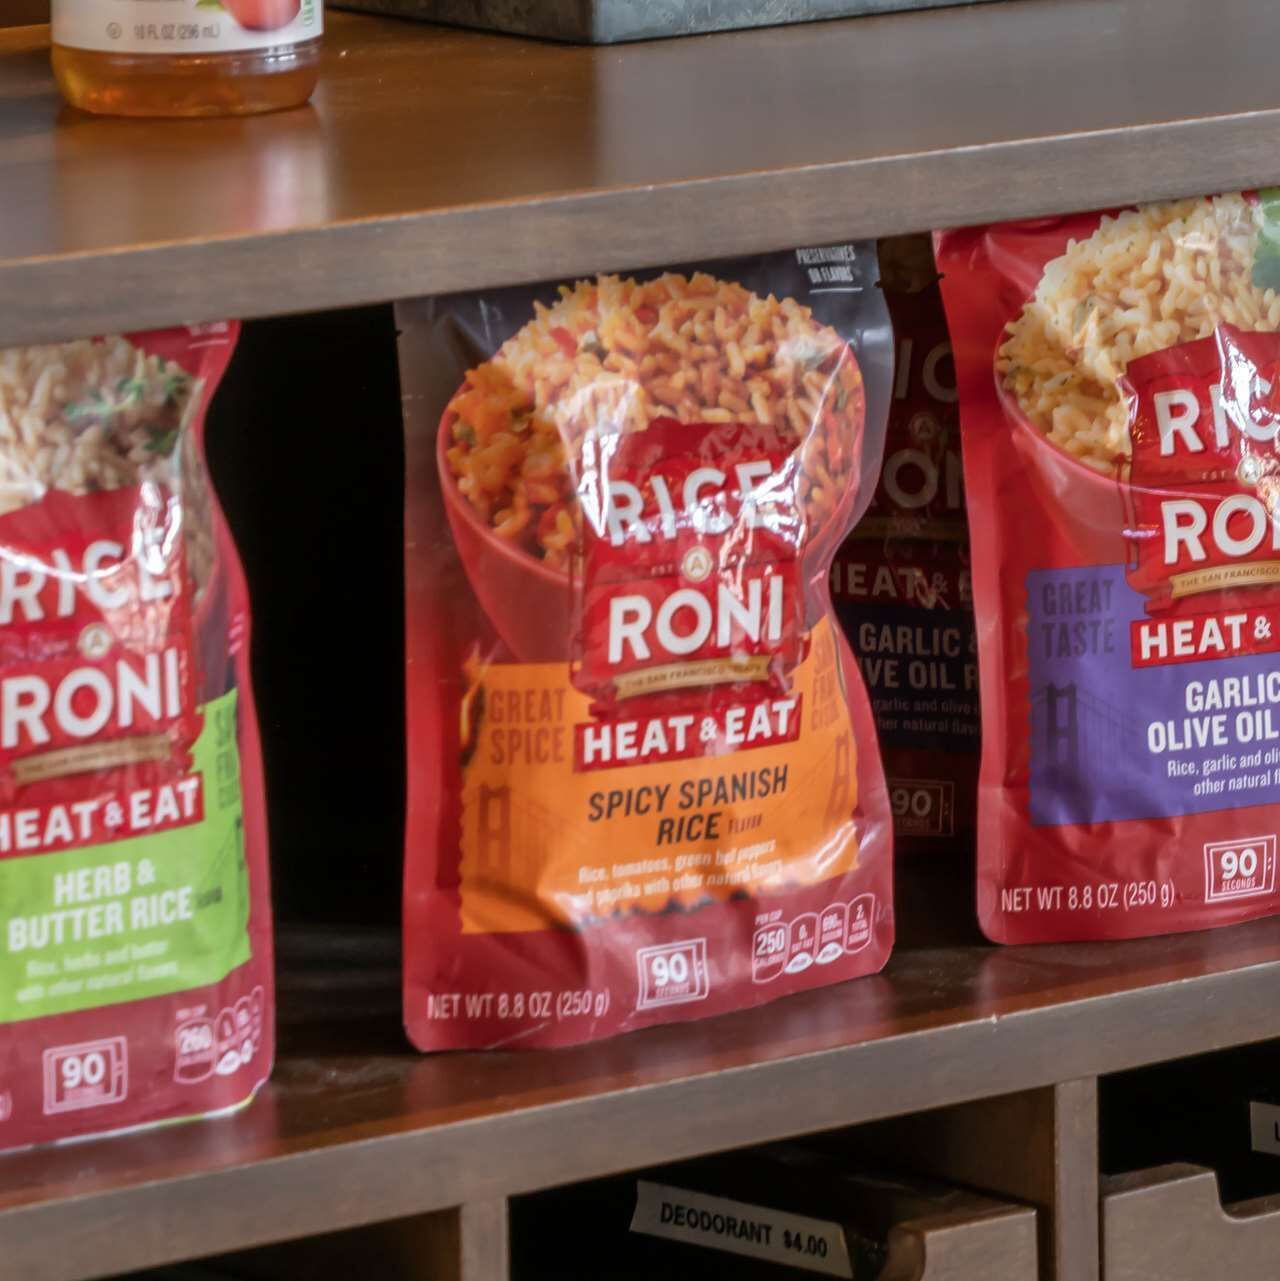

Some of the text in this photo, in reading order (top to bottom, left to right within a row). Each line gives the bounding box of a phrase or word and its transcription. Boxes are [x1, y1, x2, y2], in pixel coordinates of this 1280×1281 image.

[608, 460, 772, 546] RICE
[1042, 580, 1114, 616] GREAT
[608, 575, 784, 665] RONI
[1043, 620, 1115, 658] TASTE
[1140, 616, 1248, 660] HEAT
[1254, 615, 1273, 639] &
[858, 623, 961, 658] GARLIC
[0, 648, 181, 748] RONI
[490, 689, 566, 723] GREAT
[490, 725, 564, 766] SPICE
[583, 699, 797, 763] HEAT & EAT
[1148, 711, 1229, 754] OLIVE
[1235, 707, 1279, 744] OIL
[1167, 759, 1201, 779] Rice,
[1203, 754, 1237, 777] garlic
[1239, 752, 1261, 769] and
[1193, 779, 1225, 797] other
[1228, 772, 1271, 791] natural
[588, 764, 788, 823] SPICY SPANISH
[54, 858, 155, 906] HERB &
[1220, 847, 1257, 880] 90
[1001, 881, 1175, 913] NET WT 8.8 OZ (250 g)
[1221, 876, 1257, 892] SECONDS
[8, 886, 194, 953] BUTTER RICE
[651, 956, 688, 987] 90
[427, 990, 611, 1020] NET WT 8.8 OZ (250 g)
[62, 1055, 105, 1088] 90
[660, 1200, 828, 1259] DEODORANT $4.00
